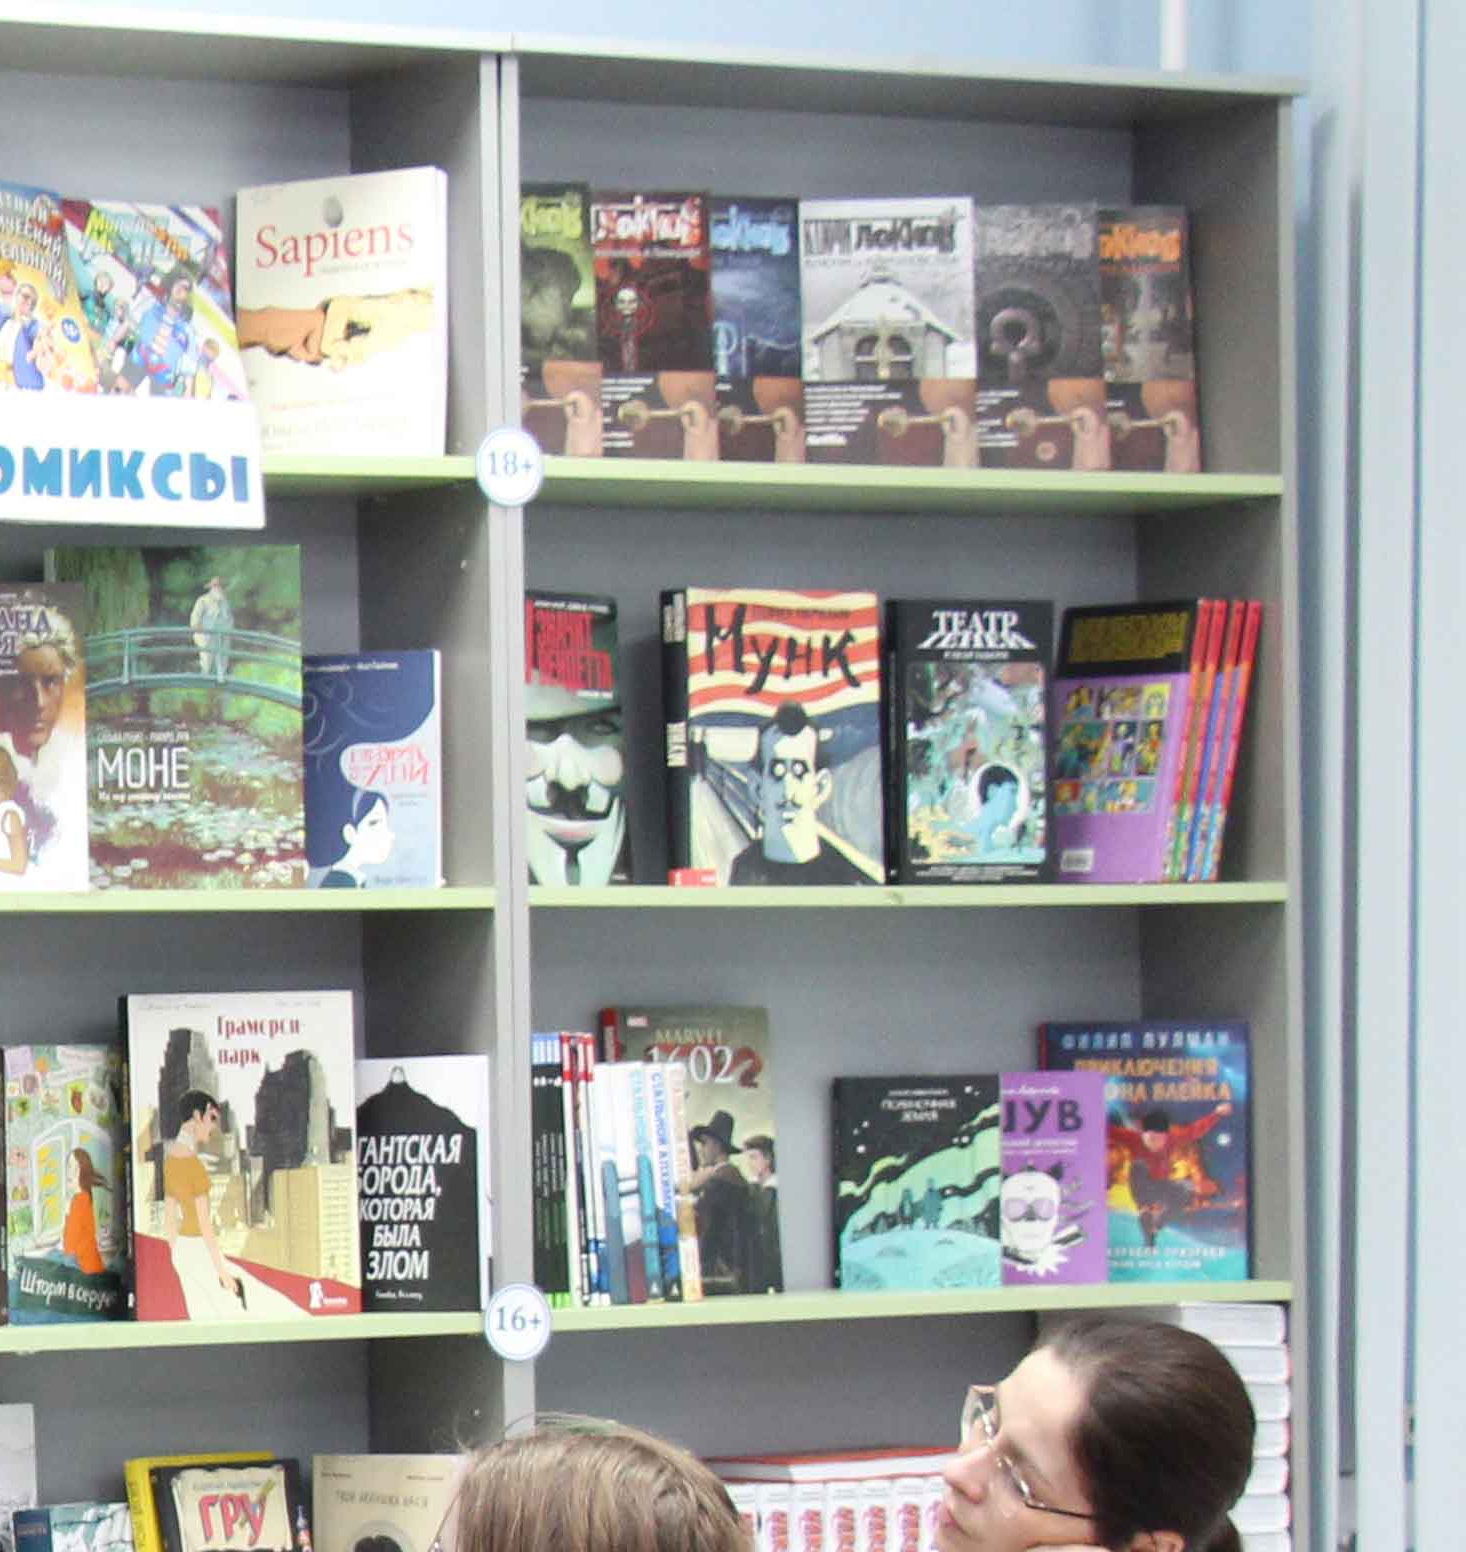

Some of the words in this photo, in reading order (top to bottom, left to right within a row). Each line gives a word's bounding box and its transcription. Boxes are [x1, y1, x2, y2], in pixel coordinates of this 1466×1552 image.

[254, 223, 415, 278] Sapiens
[488, 449, 533, 477] 18+
[932, 609, 1020, 638] ТЕАТР
[97, 747, 191, 789] МОНЕ
[656, 1028, 724, 1044] MARVEL
[1061, 1032, 1132, 1050] ФИЛИП
[217, 1047, 262, 1068] парк
[372, 1224, 422, 1248] БЫЛА
[365, 1250, 430, 1282] ЗЛОМ
[20, 1266, 67, 1305] Шторм
[494, 1304, 544, 1332] 16+
[198, 1493, 268, 1547] ГРУ
